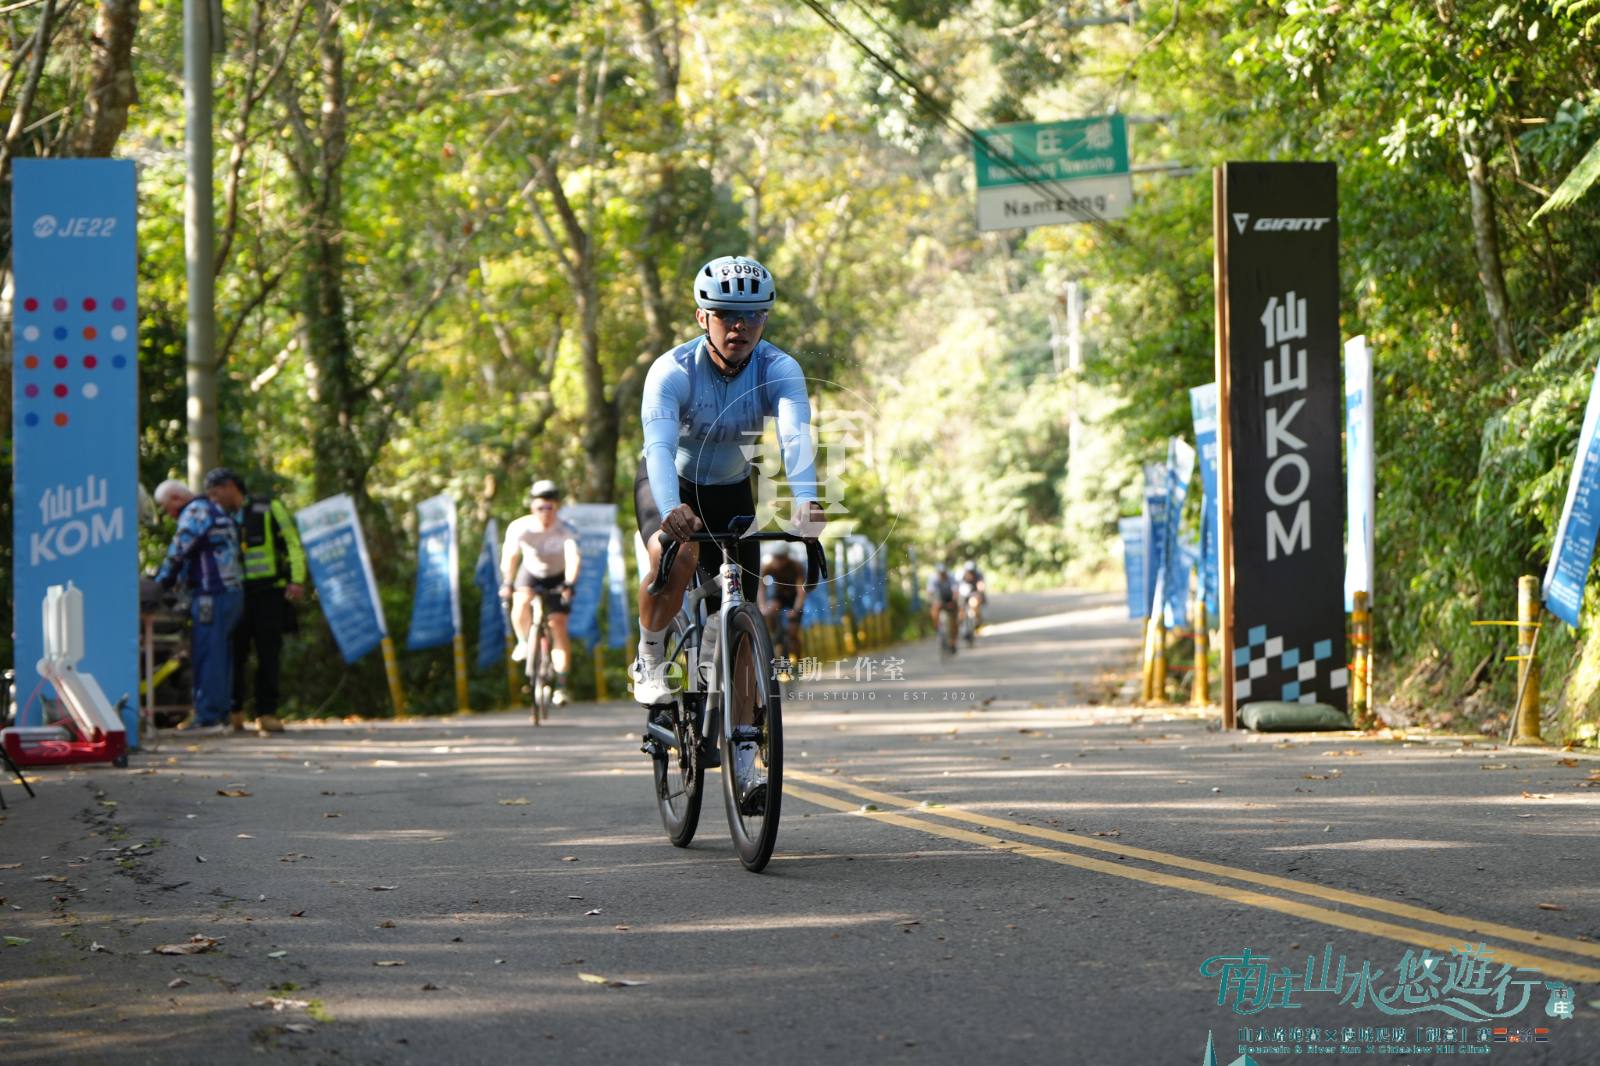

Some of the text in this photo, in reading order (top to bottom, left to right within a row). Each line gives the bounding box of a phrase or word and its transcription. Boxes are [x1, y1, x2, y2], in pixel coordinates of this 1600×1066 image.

[58, 217, 117, 238] JE22
[1253, 217, 1330, 231] GIANT
[39, 474, 107, 527] 仙山
[30, 506, 124, 567] KOM
